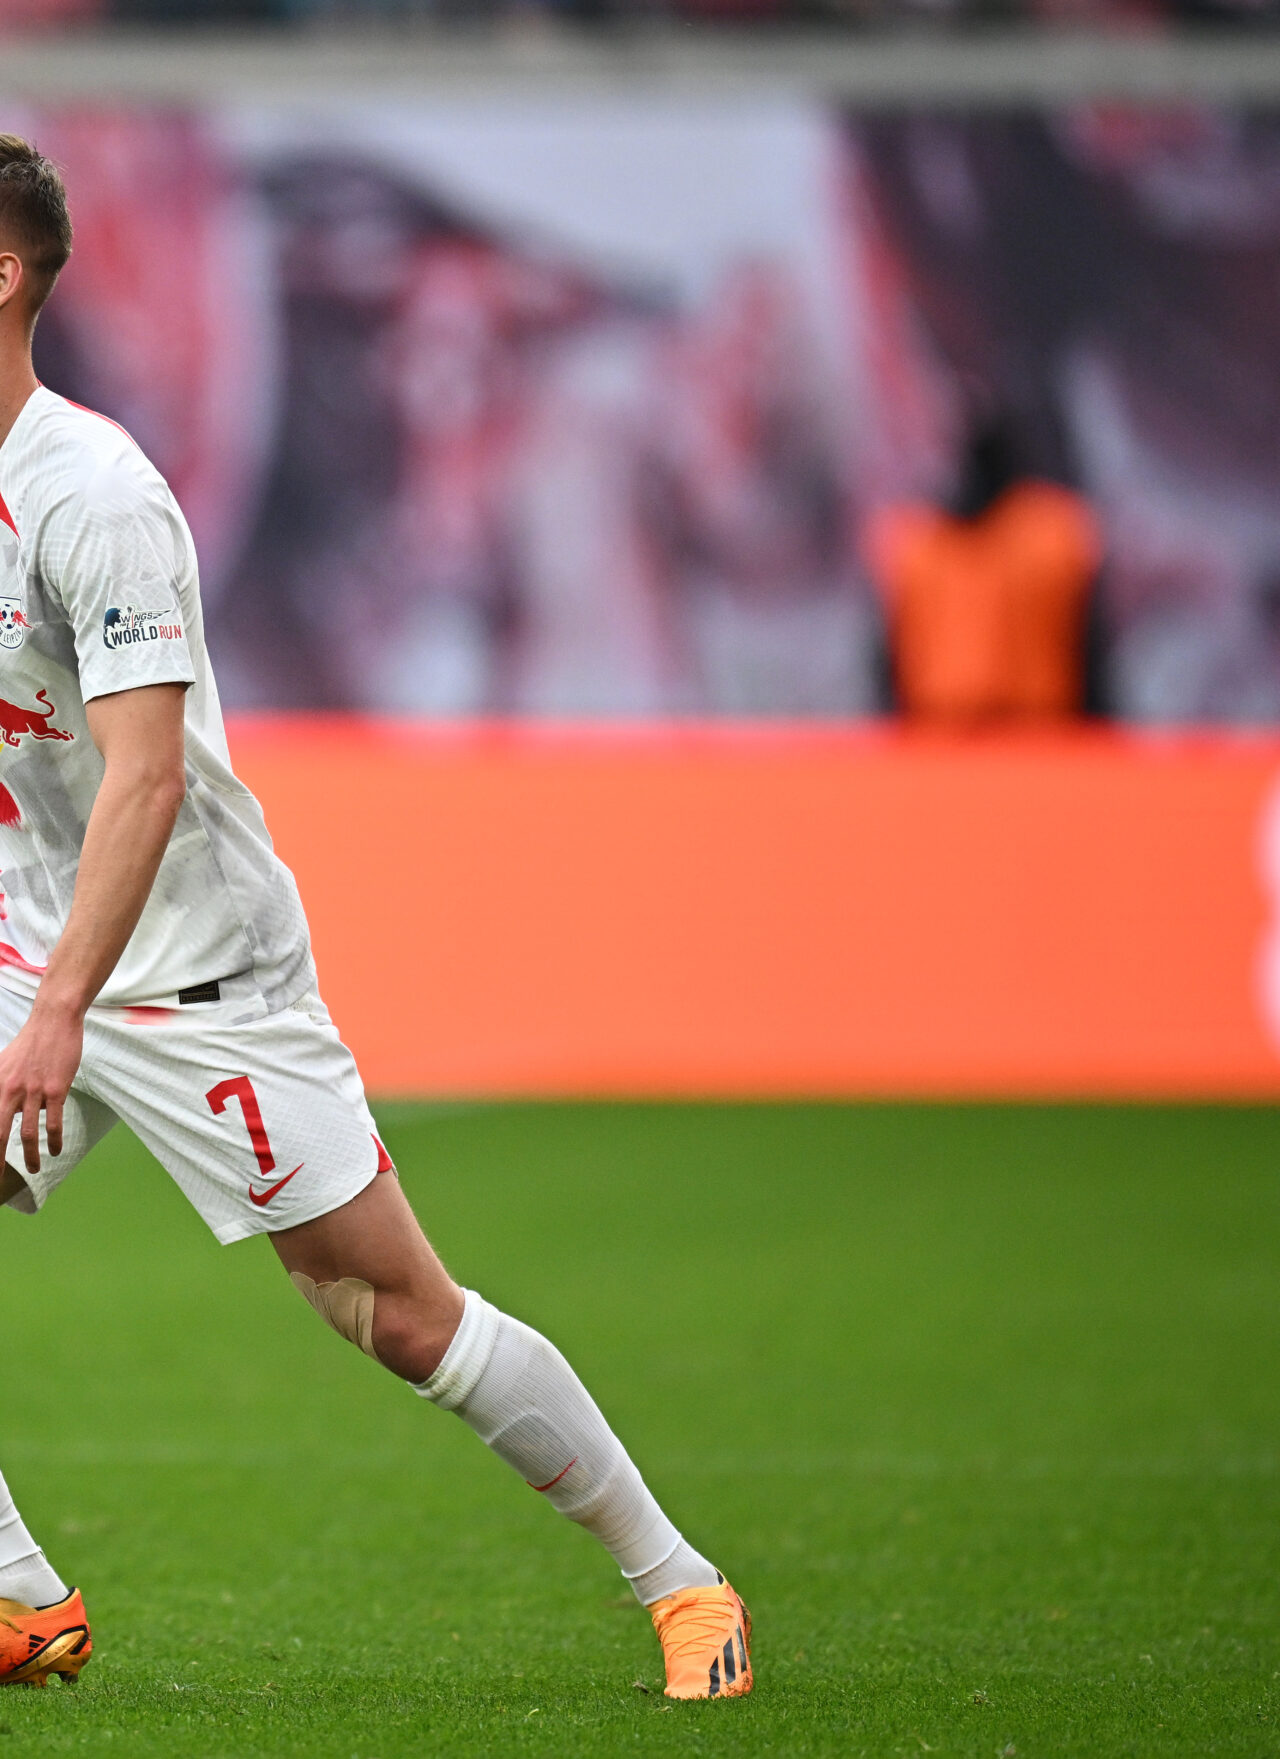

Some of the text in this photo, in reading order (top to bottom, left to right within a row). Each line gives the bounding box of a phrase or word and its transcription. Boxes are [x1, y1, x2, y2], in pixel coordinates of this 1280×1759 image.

[111, 624, 182, 646] WORLD RUN
[205, 1075, 276, 1176] 7
